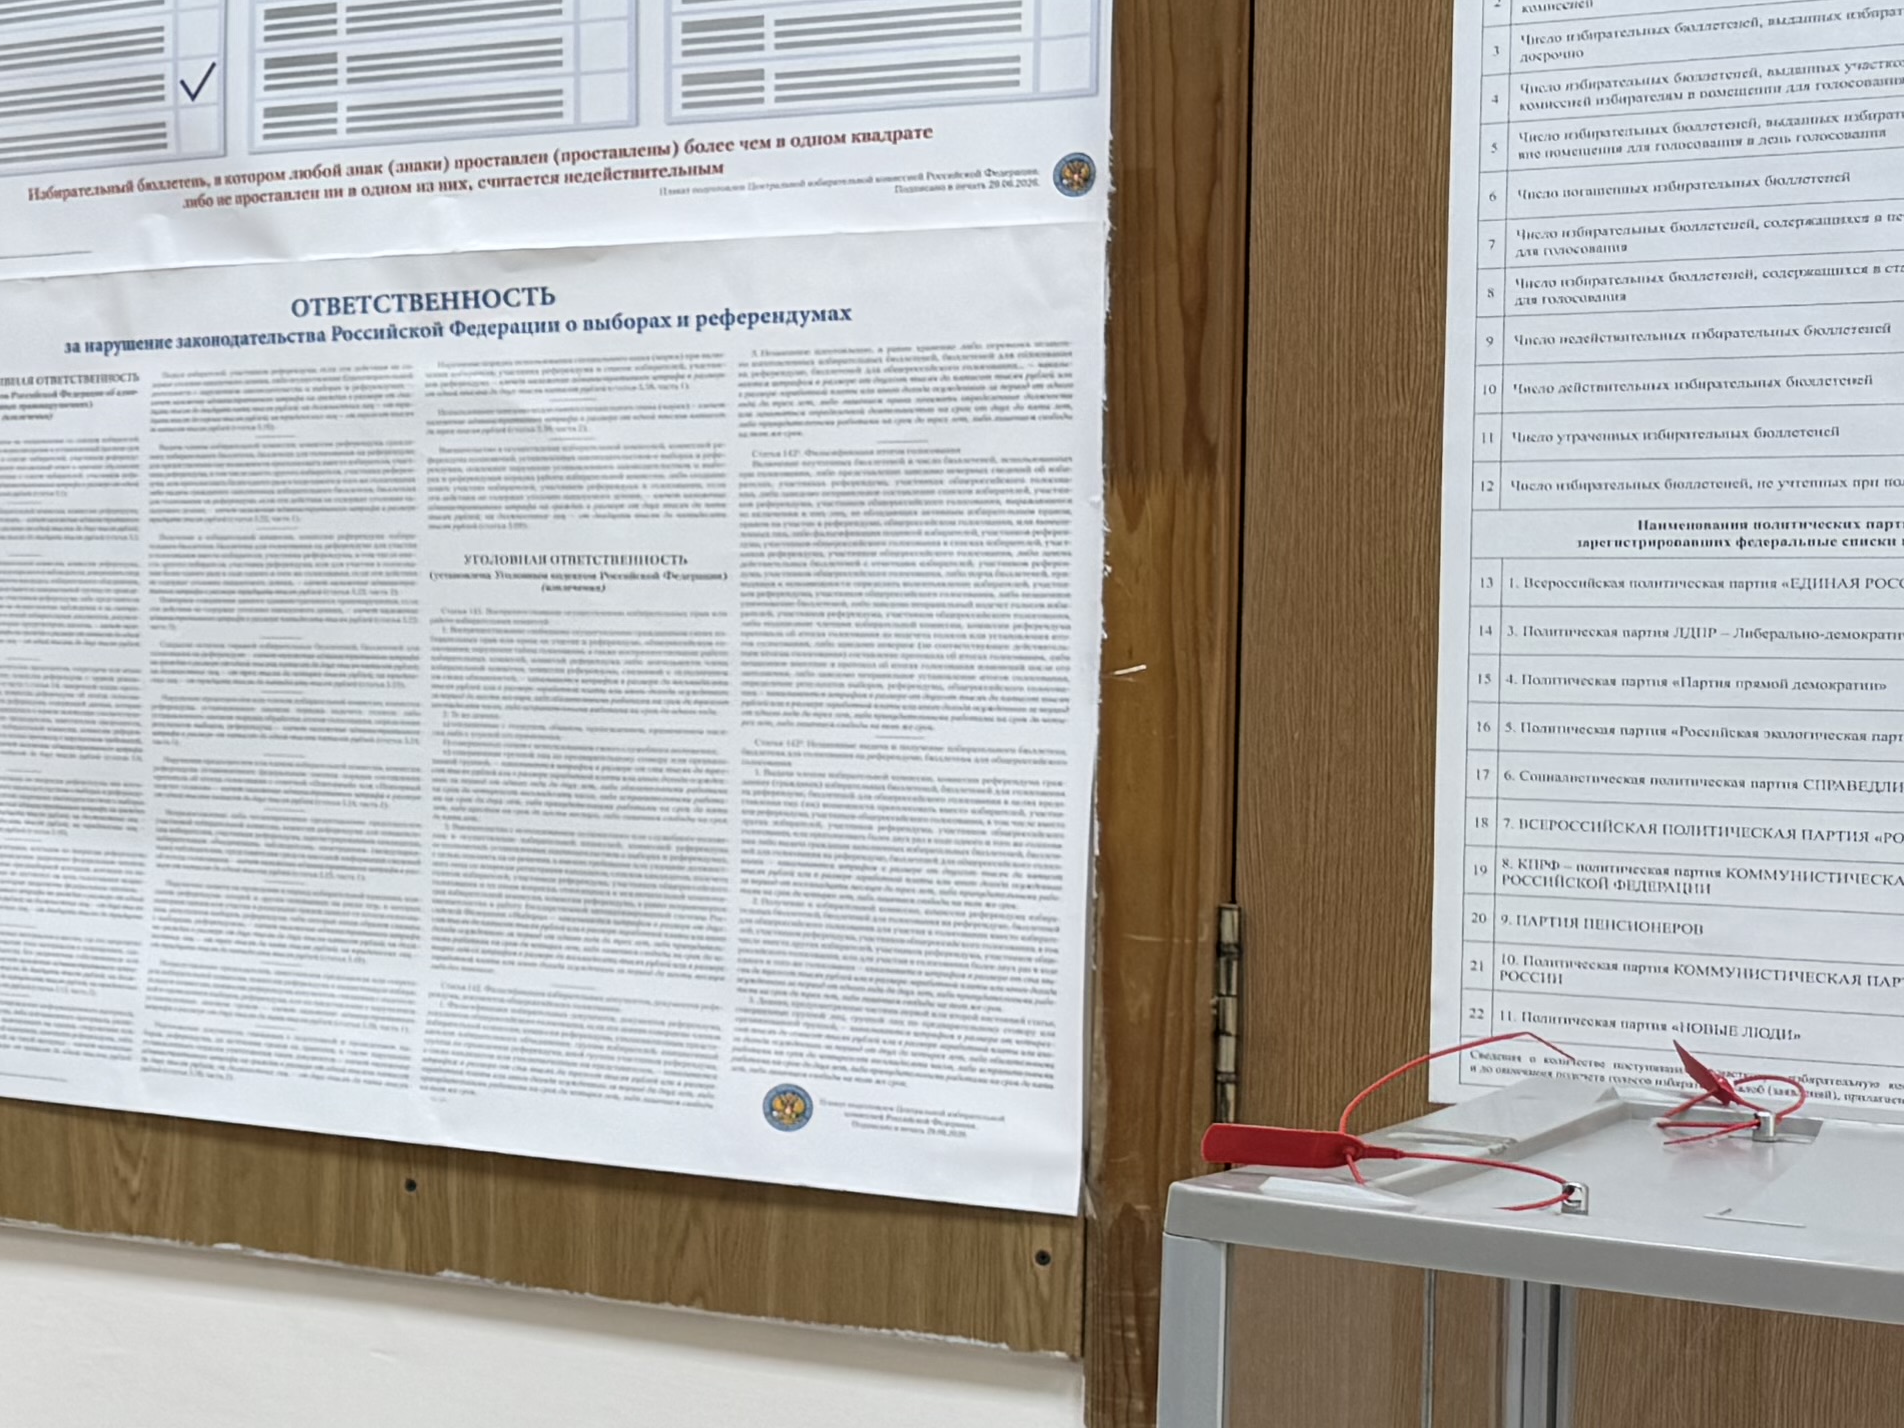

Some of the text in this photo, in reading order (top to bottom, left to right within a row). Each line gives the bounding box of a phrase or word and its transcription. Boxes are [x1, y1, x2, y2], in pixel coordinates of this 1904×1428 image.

[213, 175, 223, 187] в
[223, 170, 286, 187] котором
[288, 163, 342, 181] любой
[345, 163, 383, 177] знак
[387, 156, 449, 178] (знаки)
[454, 153, 548, 173] проставлен
[552, 139, 679, 166] (проставлены)
[683, 137, 735, 154] более
[739, 138, 771, 151] чем
[775, 137, 785, 149] в
[789, 133, 846, 148] одном
[851, 127, 933, 145] квадрате
[216, 195, 232, 207] не
[234, 189, 319, 208] проставлен
[323, 187, 343, 199] ни
[347, 187, 357, 197] в
[360, 183, 411, 197] одном
[415, 181, 434, 193] из
[437, 178, 473, 192] них,
[477, 173, 559, 189] считается
[563, 163, 724, 184] недействительным
[290, 285, 556, 317] ОТВЕТСТВЕННОСТЬ
[63, 307, 852, 357] за нарушение законодательства Российской Федерации о выборах и референдумах
[1503, 817, 1513, 829] 7.
[1519, 818, 1657, 835] ВСЕРОССИЙСКАЯ
[1662, 823, 1796, 840] ПОЛИТИЧЕСКАЯ
[1801, 828, 1869, 843] ПАРТИЯ
[1471, 912, 1703, 935] 20 9. ПАРТИЯ ПЕНСИОНЕРОВ
[1468, 1007, 1801, 1041] 22 11. Политическая партия «НОВЫЕ ЛЮДИ»
